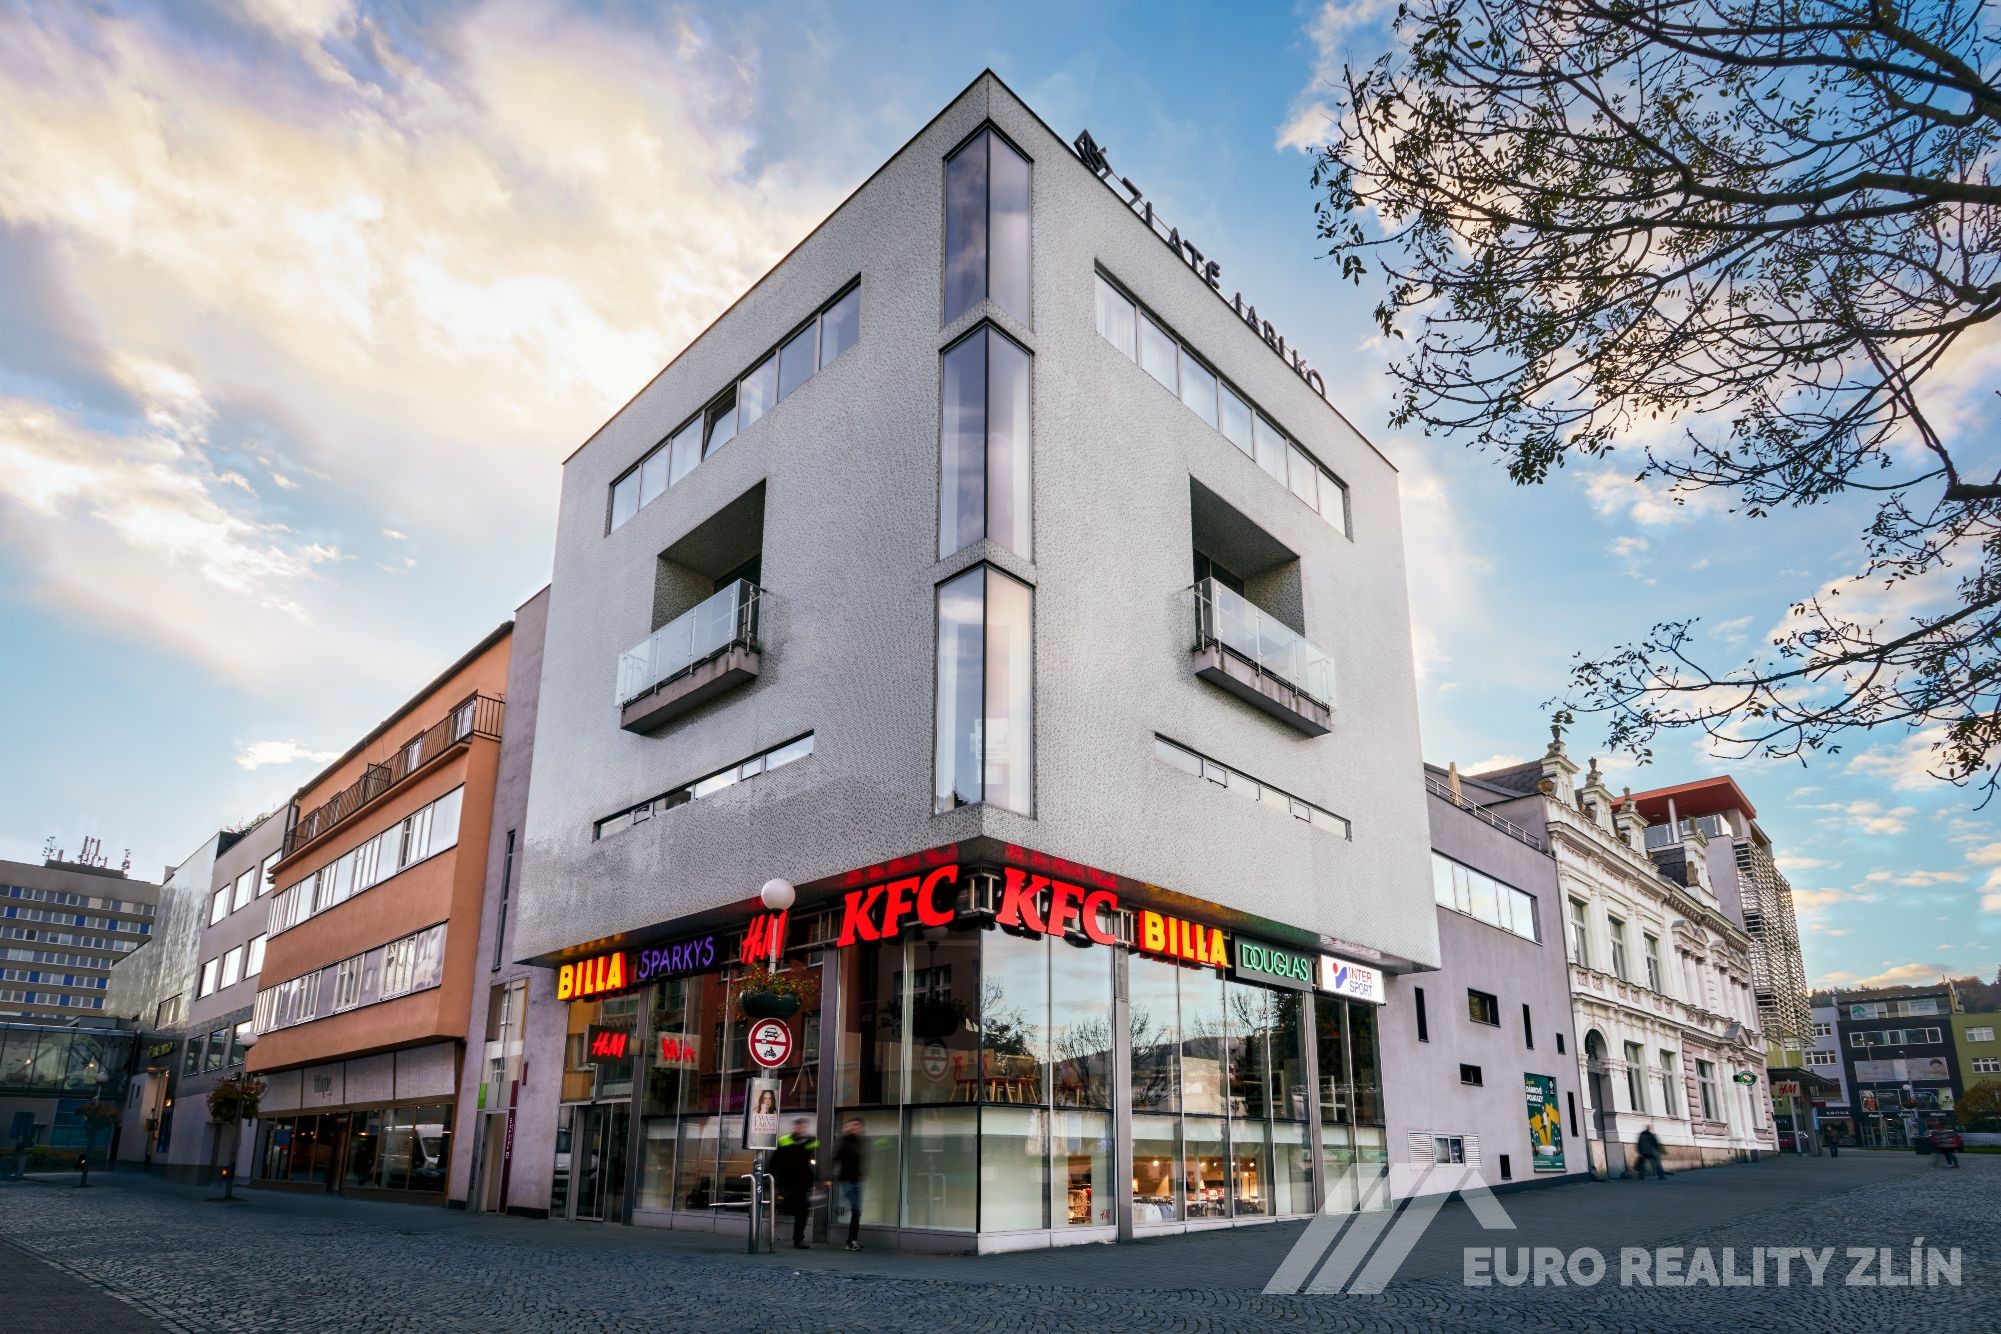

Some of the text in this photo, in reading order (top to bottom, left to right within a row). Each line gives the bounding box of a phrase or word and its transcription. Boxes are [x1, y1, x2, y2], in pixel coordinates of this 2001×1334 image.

[836, 864, 959, 947] KFC
[996, 866, 1118, 945] KFC
[638, 936, 714, 979] SPARKYS
[741, 909, 788, 964] H&M
[1139, 910, 1228, 967] BILLA
[557, 952, 626, 1000] BILLA
[1240, 943, 1309, 981] DOUGLAS
[1348, 966, 1372, 984] INTER
[1350, 980, 1372, 997] SPORT
[591, 1031, 627, 1059] H&M
